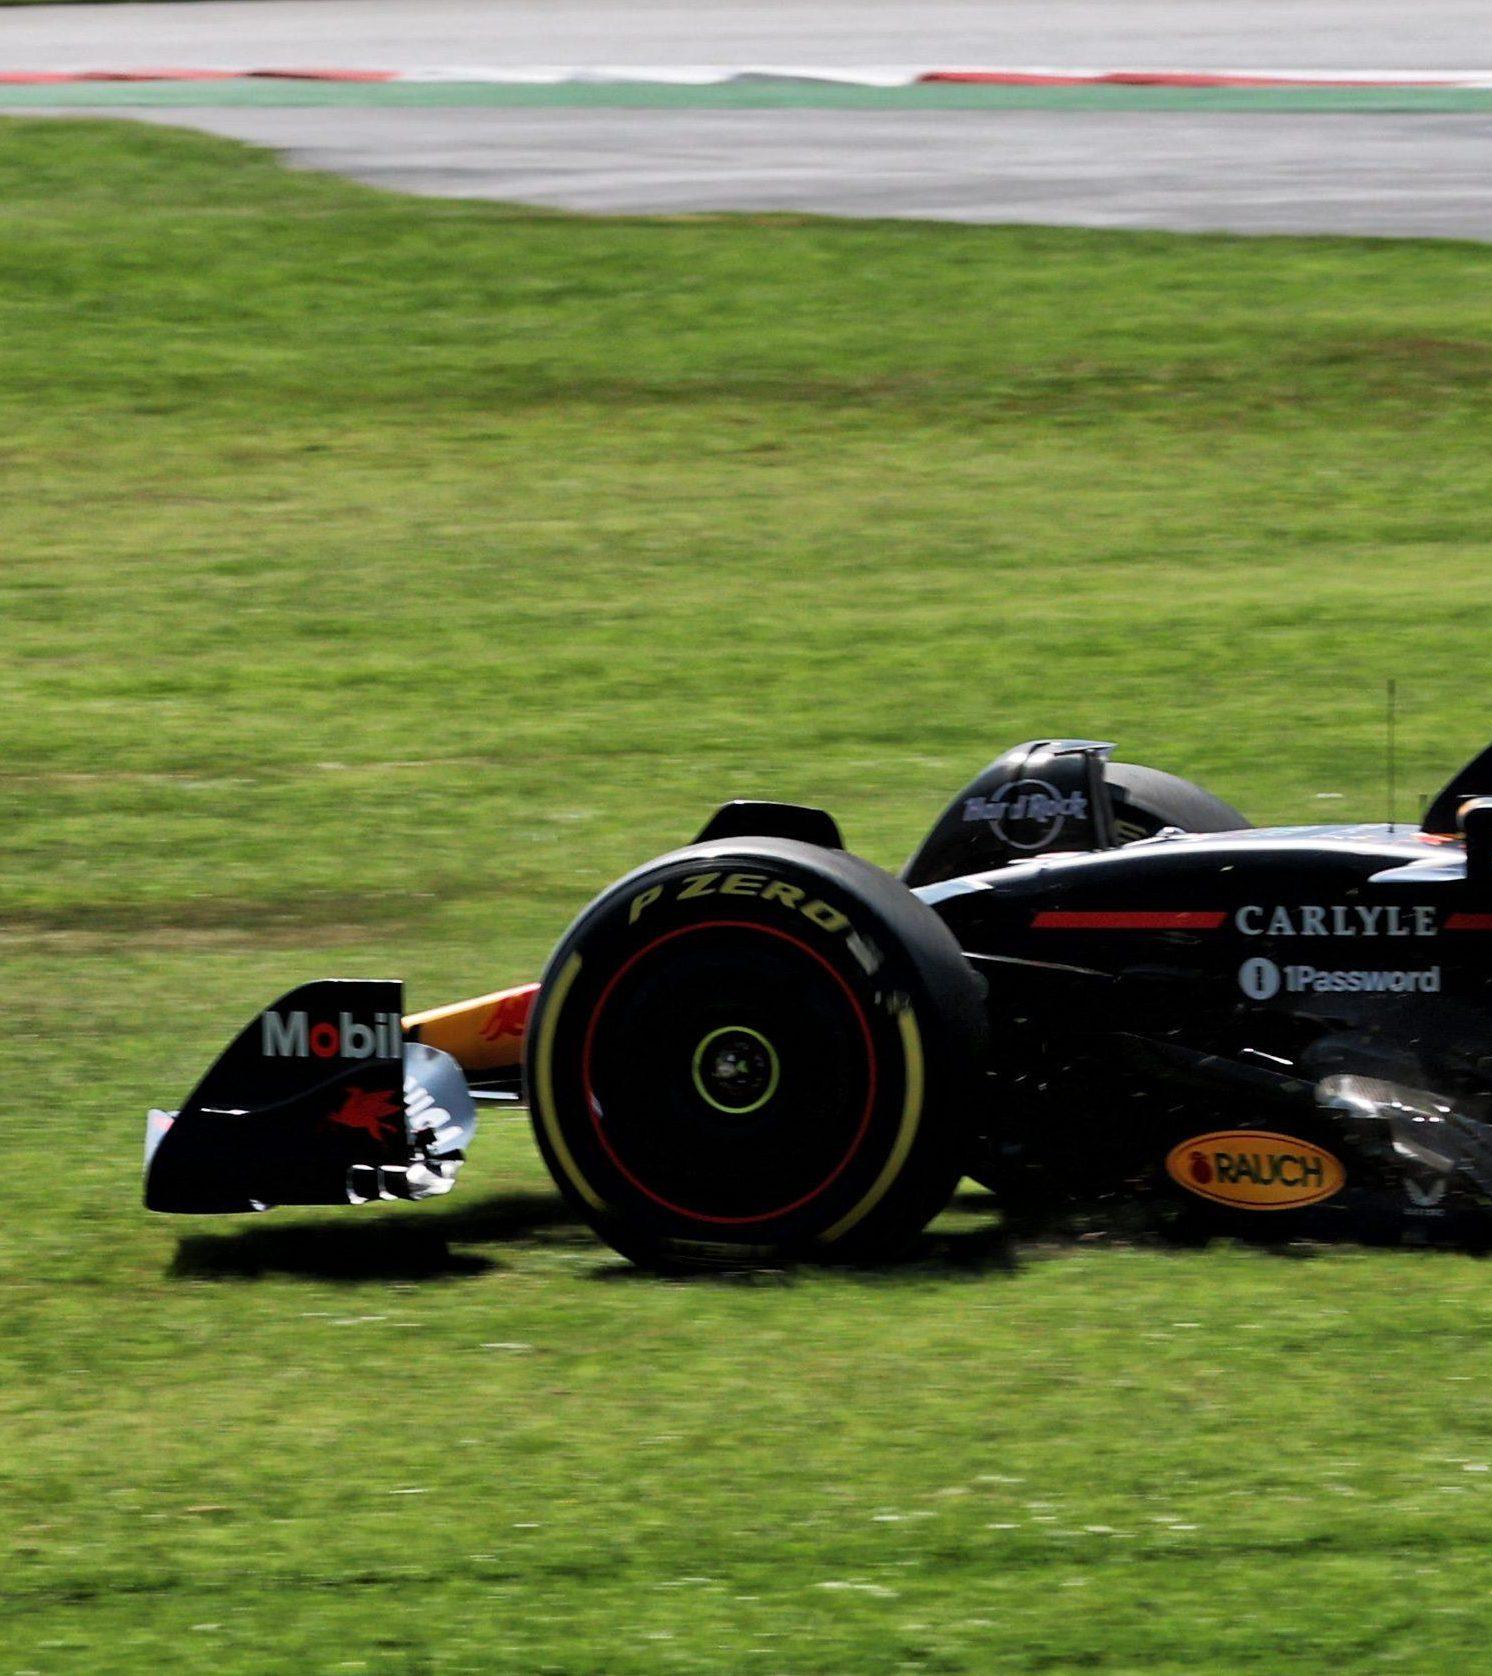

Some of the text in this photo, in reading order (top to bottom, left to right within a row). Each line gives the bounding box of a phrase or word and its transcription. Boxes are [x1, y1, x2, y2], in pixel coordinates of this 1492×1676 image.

[628, 872, 850, 933] P ZERO
[1235, 905, 1438, 936] CARLYLE
[1283, 965, 1441, 992] 1Password
[262, 1010, 401, 1059] Mobil
[1213, 1152, 1324, 1187] RAUCH
